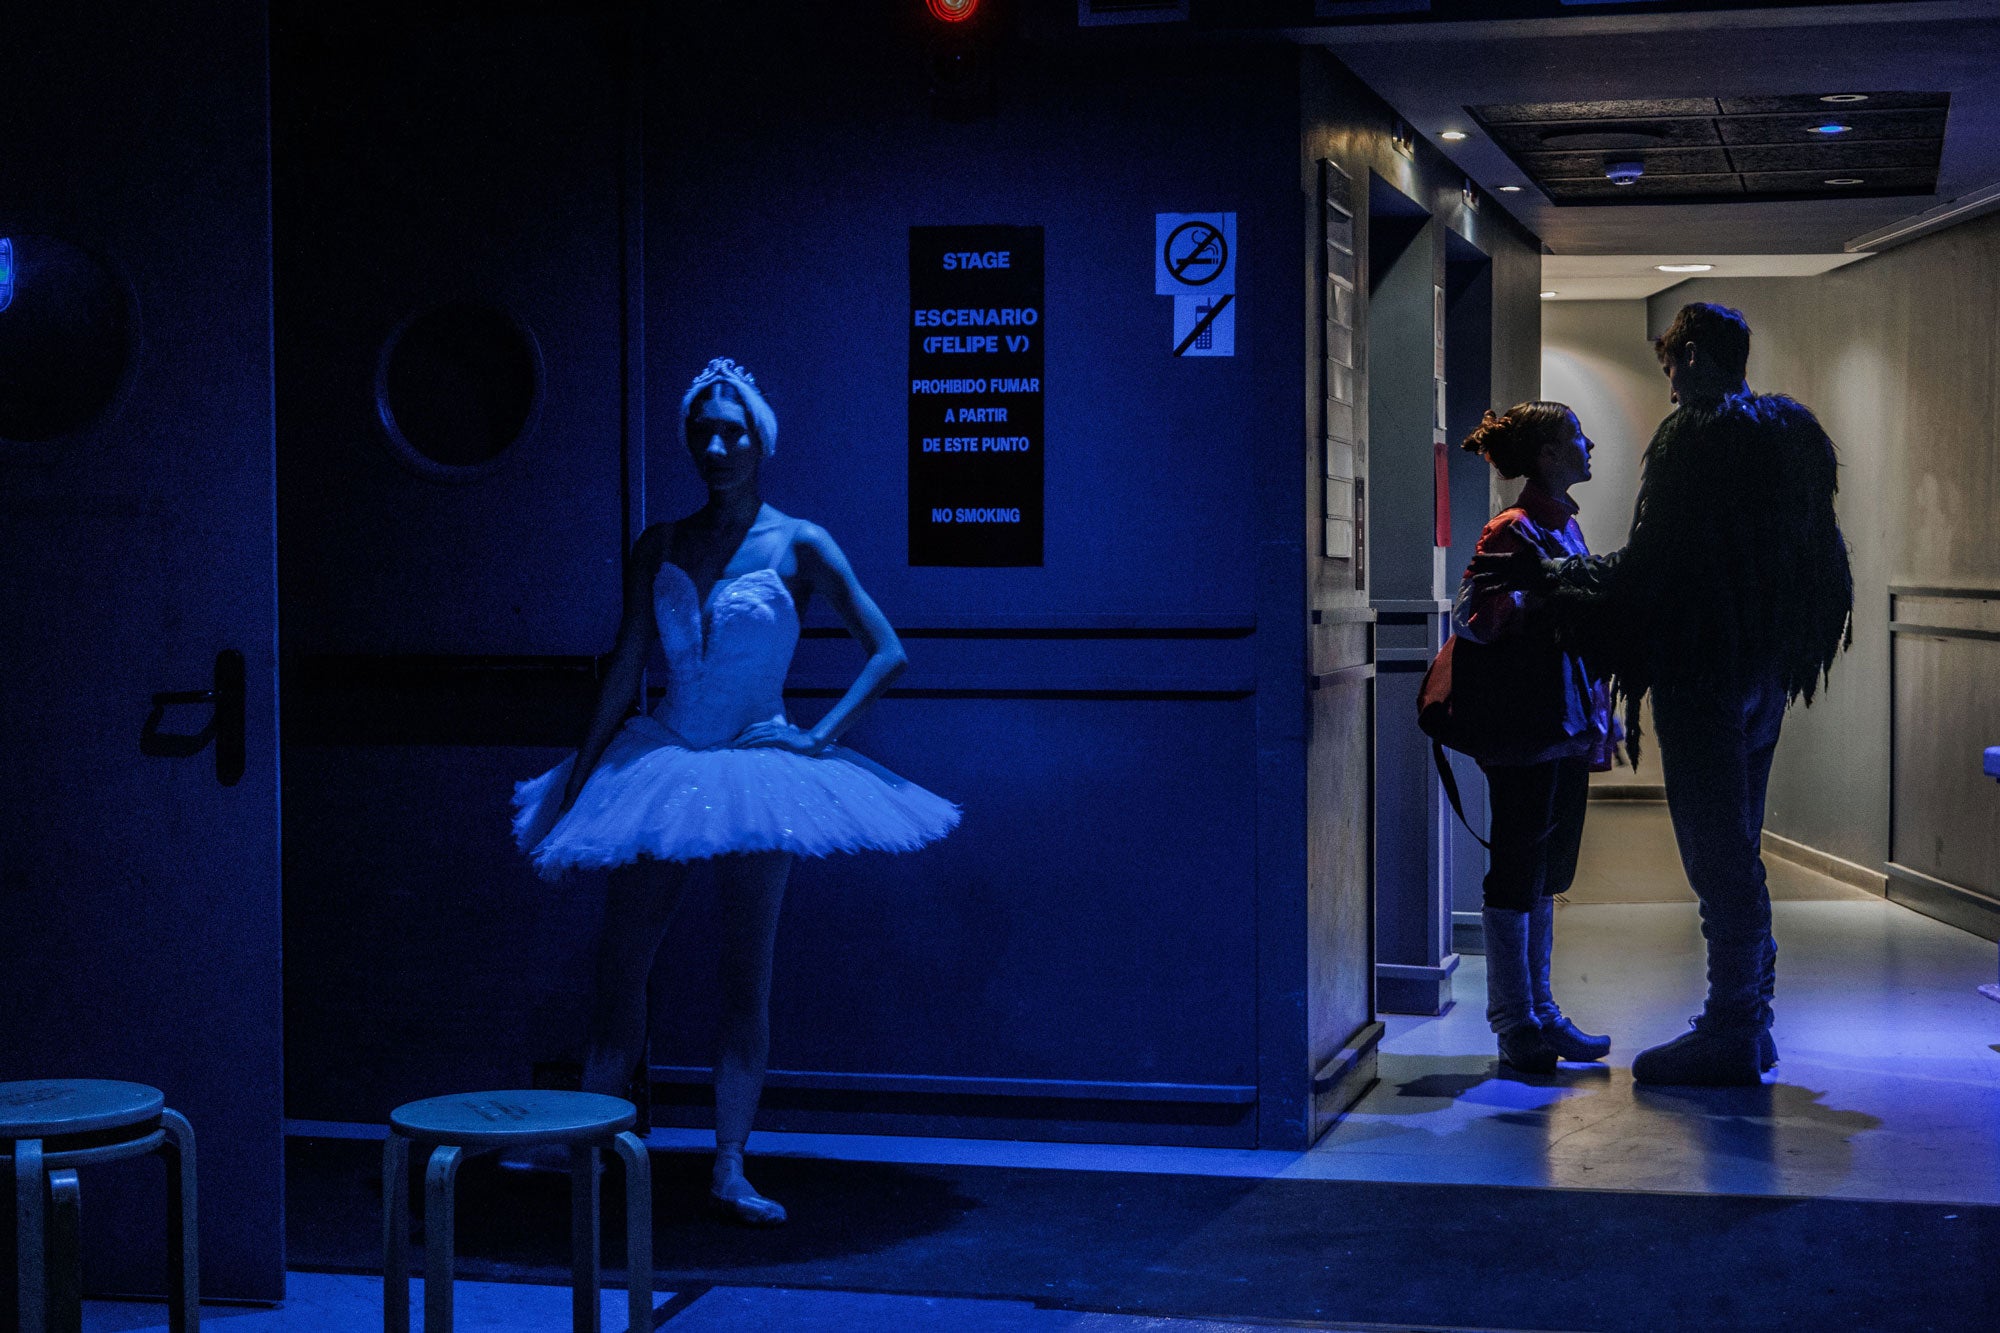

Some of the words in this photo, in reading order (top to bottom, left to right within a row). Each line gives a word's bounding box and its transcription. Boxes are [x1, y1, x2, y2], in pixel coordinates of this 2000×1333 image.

[943, 251, 1011, 271] STAGE
[914, 308, 1039, 327] ESCENARIO
[923, 335, 999, 354] (FELIPE
[1005, 335, 1030, 354] V)
[912, 378, 987, 395] PROHIBIDO
[990, 378, 1040, 394] FUMAR
[944, 408, 956, 423] A
[958, 407, 1008, 423] PARTIR
[922, 437, 941, 453] DE
[944, 436, 979, 452] ESTE
[981, 436, 1030, 452] PUNTO
[931, 507, 953, 523] NO
[955, 507, 1021, 523] SMOKING
